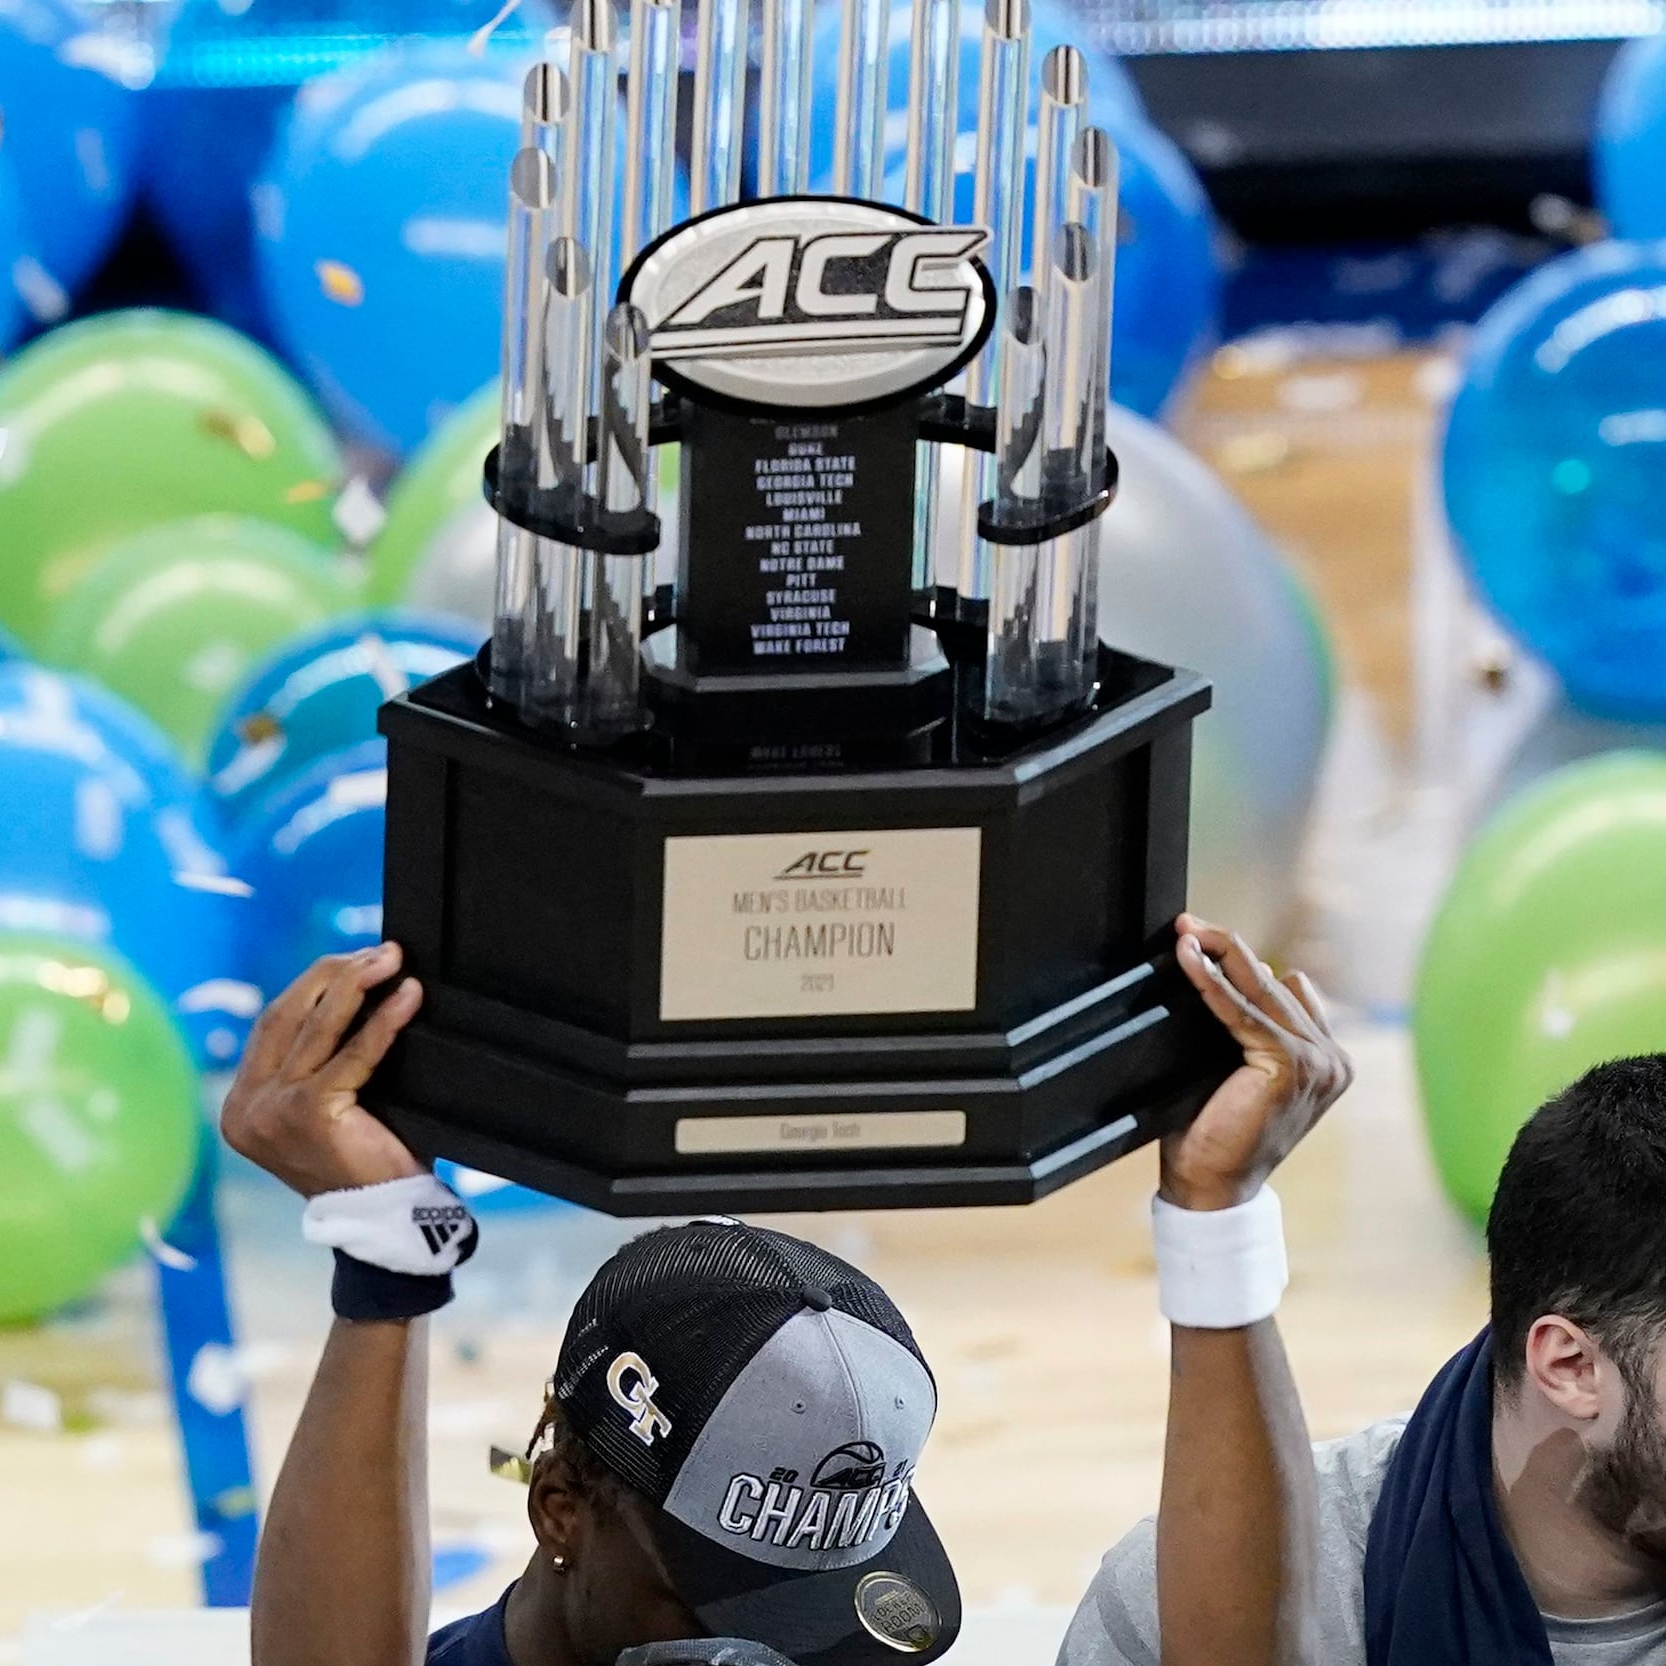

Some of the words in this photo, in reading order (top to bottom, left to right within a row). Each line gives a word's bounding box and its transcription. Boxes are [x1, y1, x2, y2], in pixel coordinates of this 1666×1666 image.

[669, 226, 993, 330] ACC
[755, 458, 812, 474] FLORIDA
[814, 456, 856, 471] STATE
[756, 475, 815, 490] GEORGIA
[820, 473, 853, 487] TECH
[783, 507, 825, 522] MIAMI
[745, 525, 791, 539] NORTH
[794, 522, 861, 538] CAROLINA
[794, 539, 834, 554] STATE
[759, 557, 803, 572] NOTRE
[806, 555, 845, 571] DAME
[786, 573, 817, 587] PITT
[766, 589, 836, 605] SYRACUSE
[770, 606, 831, 621] VIRGINIA
[751, 623, 811, 638] VIRGINIA
[815, 621, 850, 636] TECH
[753, 640, 791, 655] WAKE
[795, 637, 846, 653] FOREST
[783, 850, 871, 875] ACC
[733, 889, 789, 913] MEN'S
[794, 887, 906, 912] BASKETBALL
[744, 921, 895, 961] CHAMPION
[606, 1351, 673, 1446] GT
[770, 1467, 798, 1484] 20
